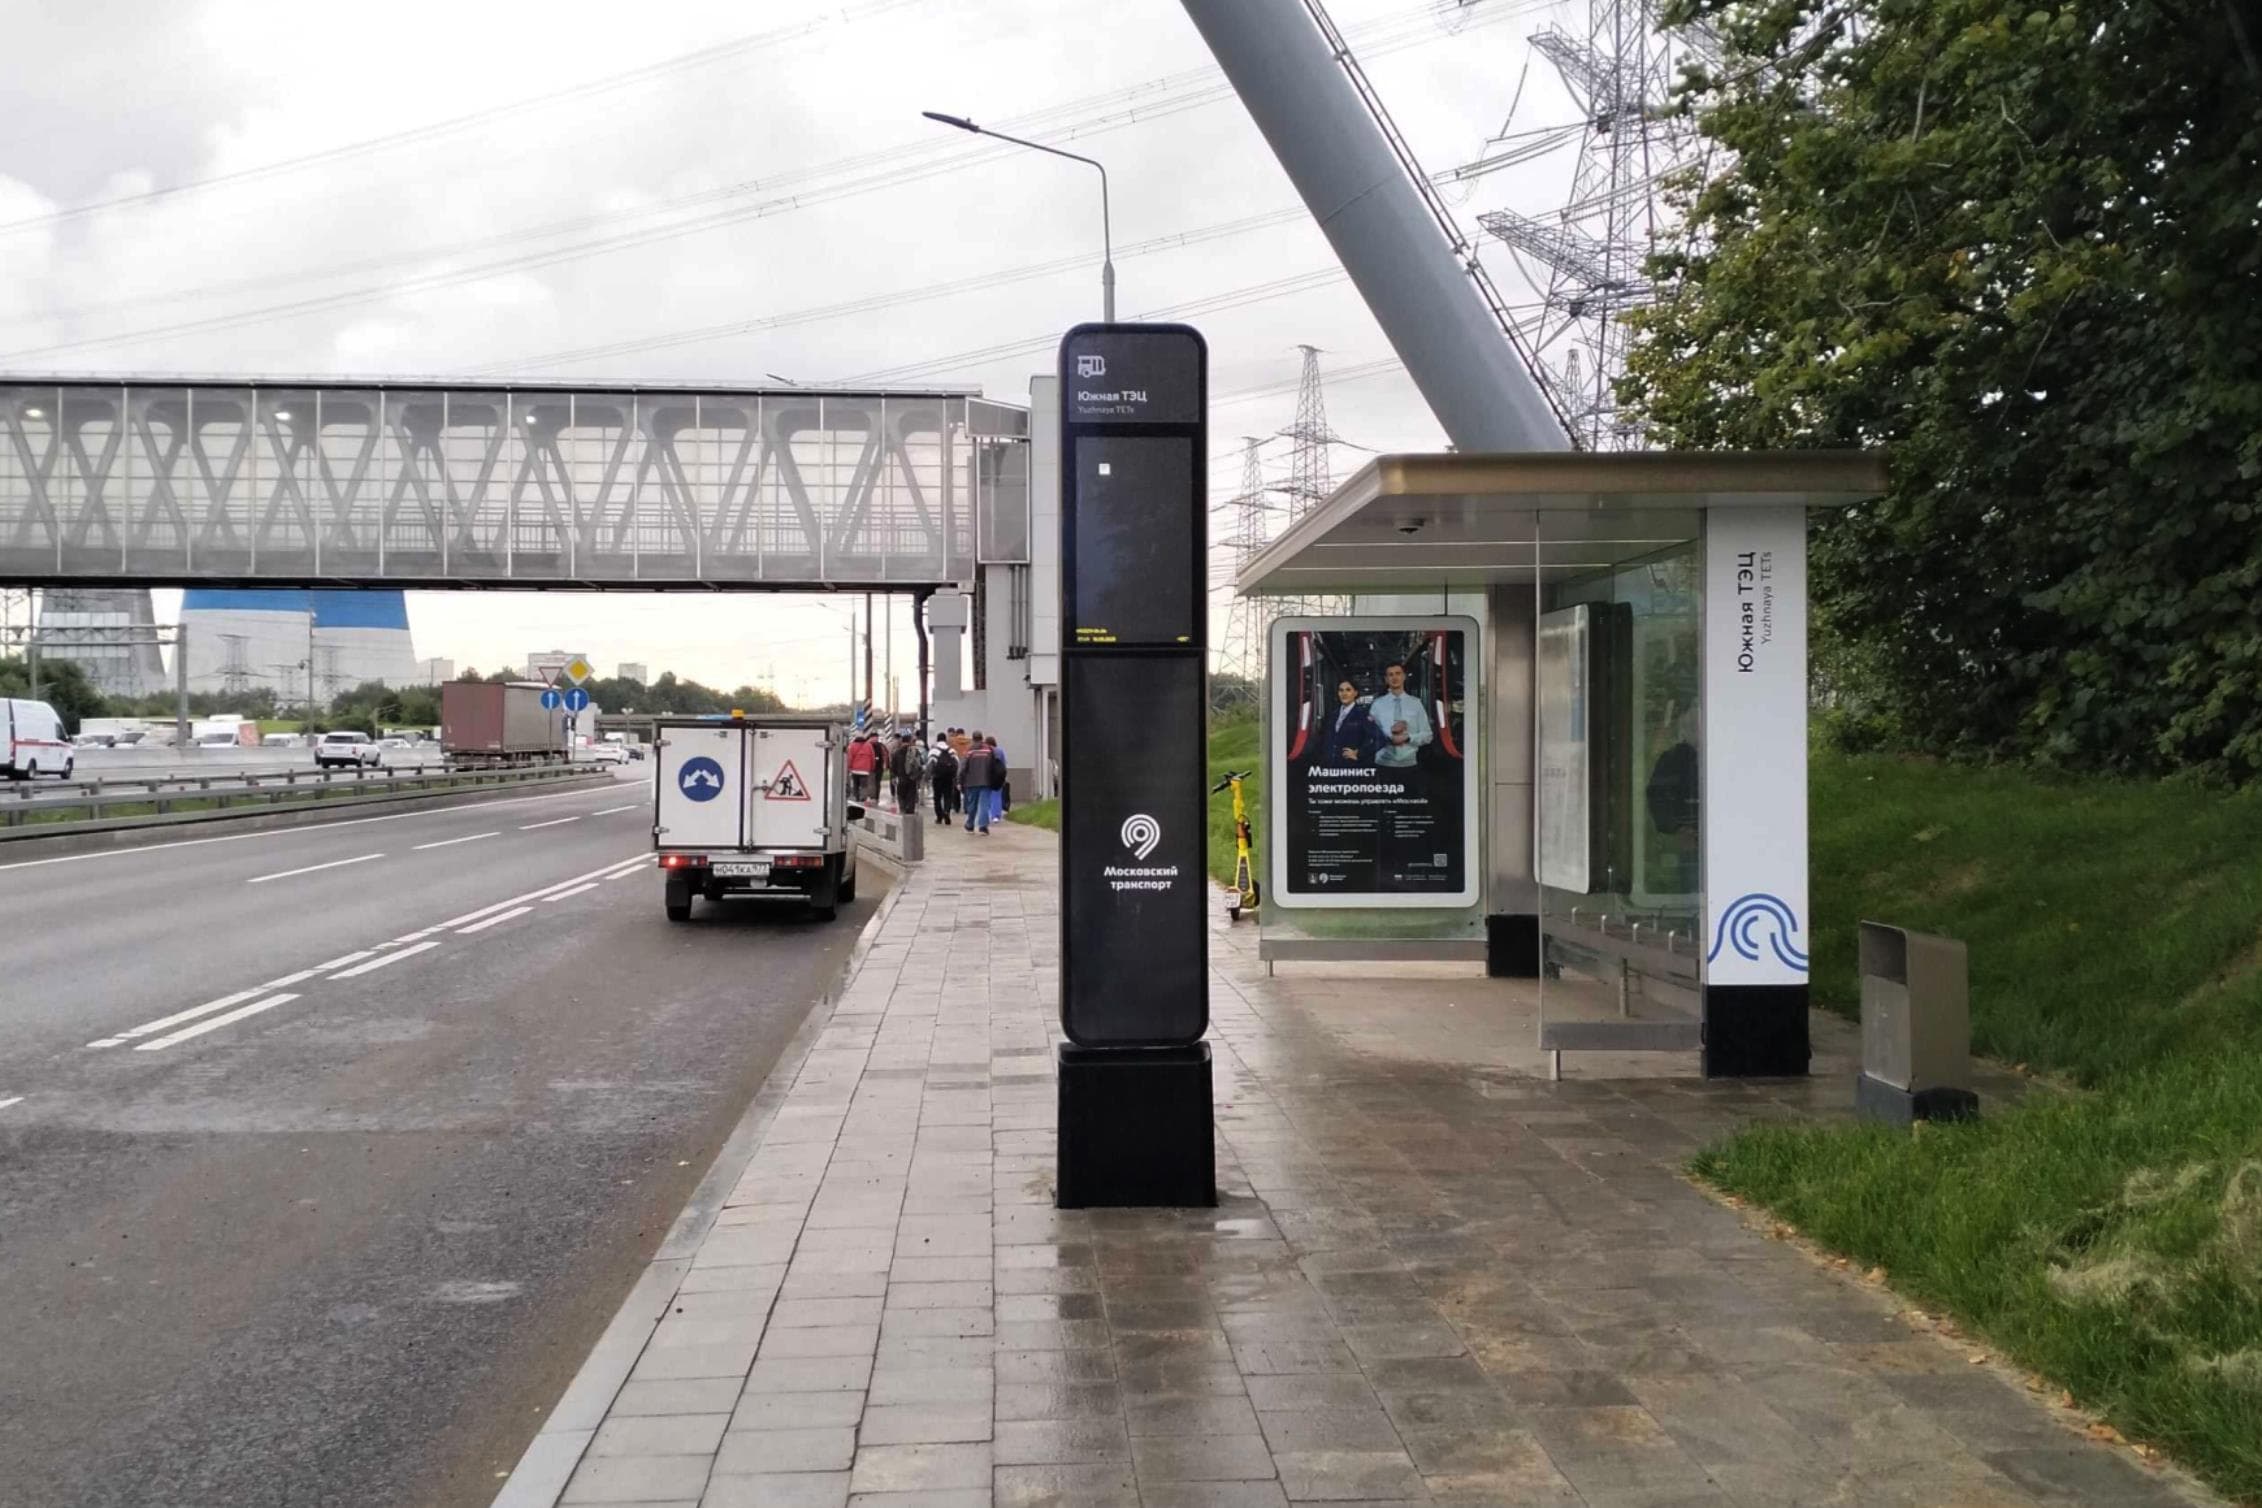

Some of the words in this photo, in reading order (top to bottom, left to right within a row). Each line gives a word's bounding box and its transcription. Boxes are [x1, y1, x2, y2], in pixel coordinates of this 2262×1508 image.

[1078, 391, 1119, 401] Южная
[1121, 391, 1147, 402] ТЭЦ
[1760, 551, 1772, 581] TETs
[1738, 552, 1756, 595] ТЭЦ
[1761, 586, 1774, 645] Yuzhnaya
[1738, 602, 1754, 672] Южная
[1308, 765, 1377, 777] Машинист
[1308, 784, 1405, 795] электропоезда
[1103, 865, 1178, 876] Московский
[1110, 881, 1172, 891] транспорт
